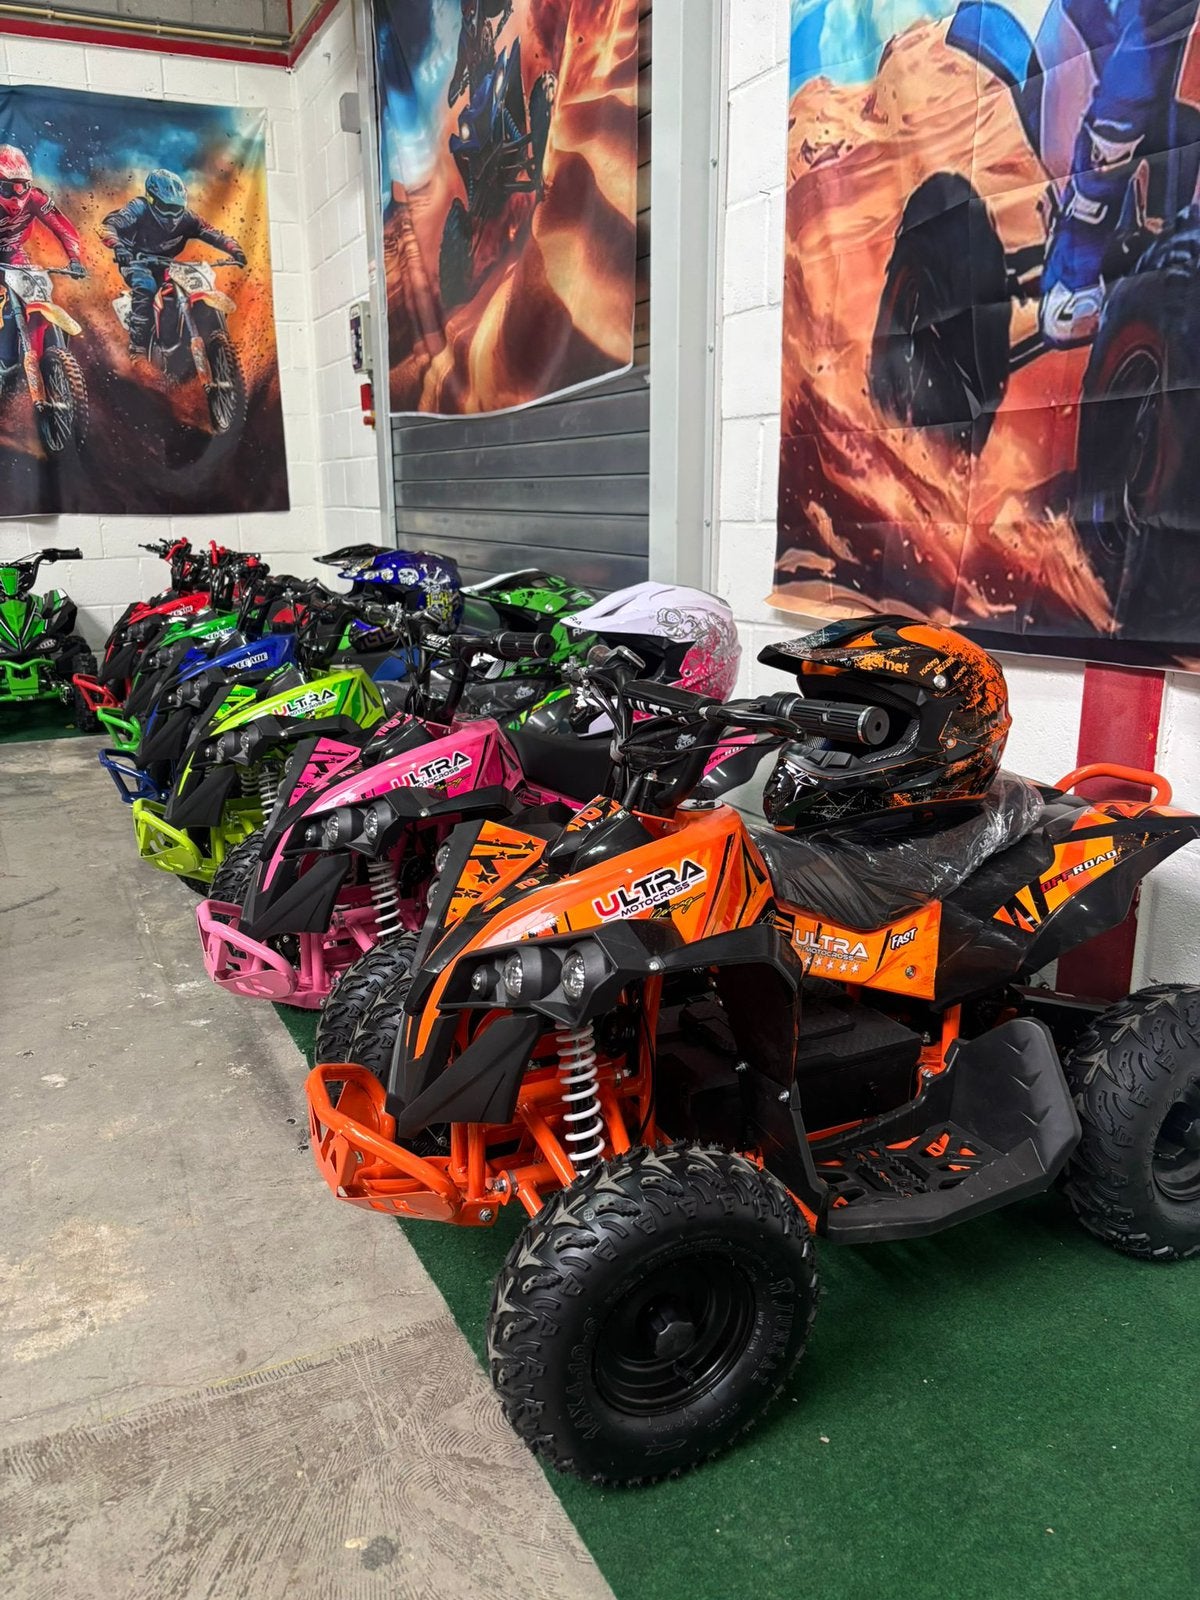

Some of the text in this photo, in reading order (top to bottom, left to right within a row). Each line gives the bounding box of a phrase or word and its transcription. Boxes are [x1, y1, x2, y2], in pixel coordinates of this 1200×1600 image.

[274, 690, 336, 716] ULTRA
[393, 752, 470, 788] ULTRA
[1040, 849, 1118, 893] OFFROAD
[594, 860, 705, 916] ULTRA
[621, 881, 690, 917] MOTOCROSS
[795, 929, 869, 958] ULTRA
[805, 947, 854, 961] MOTOCROSS
[890, 927, 918, 950] FAST
